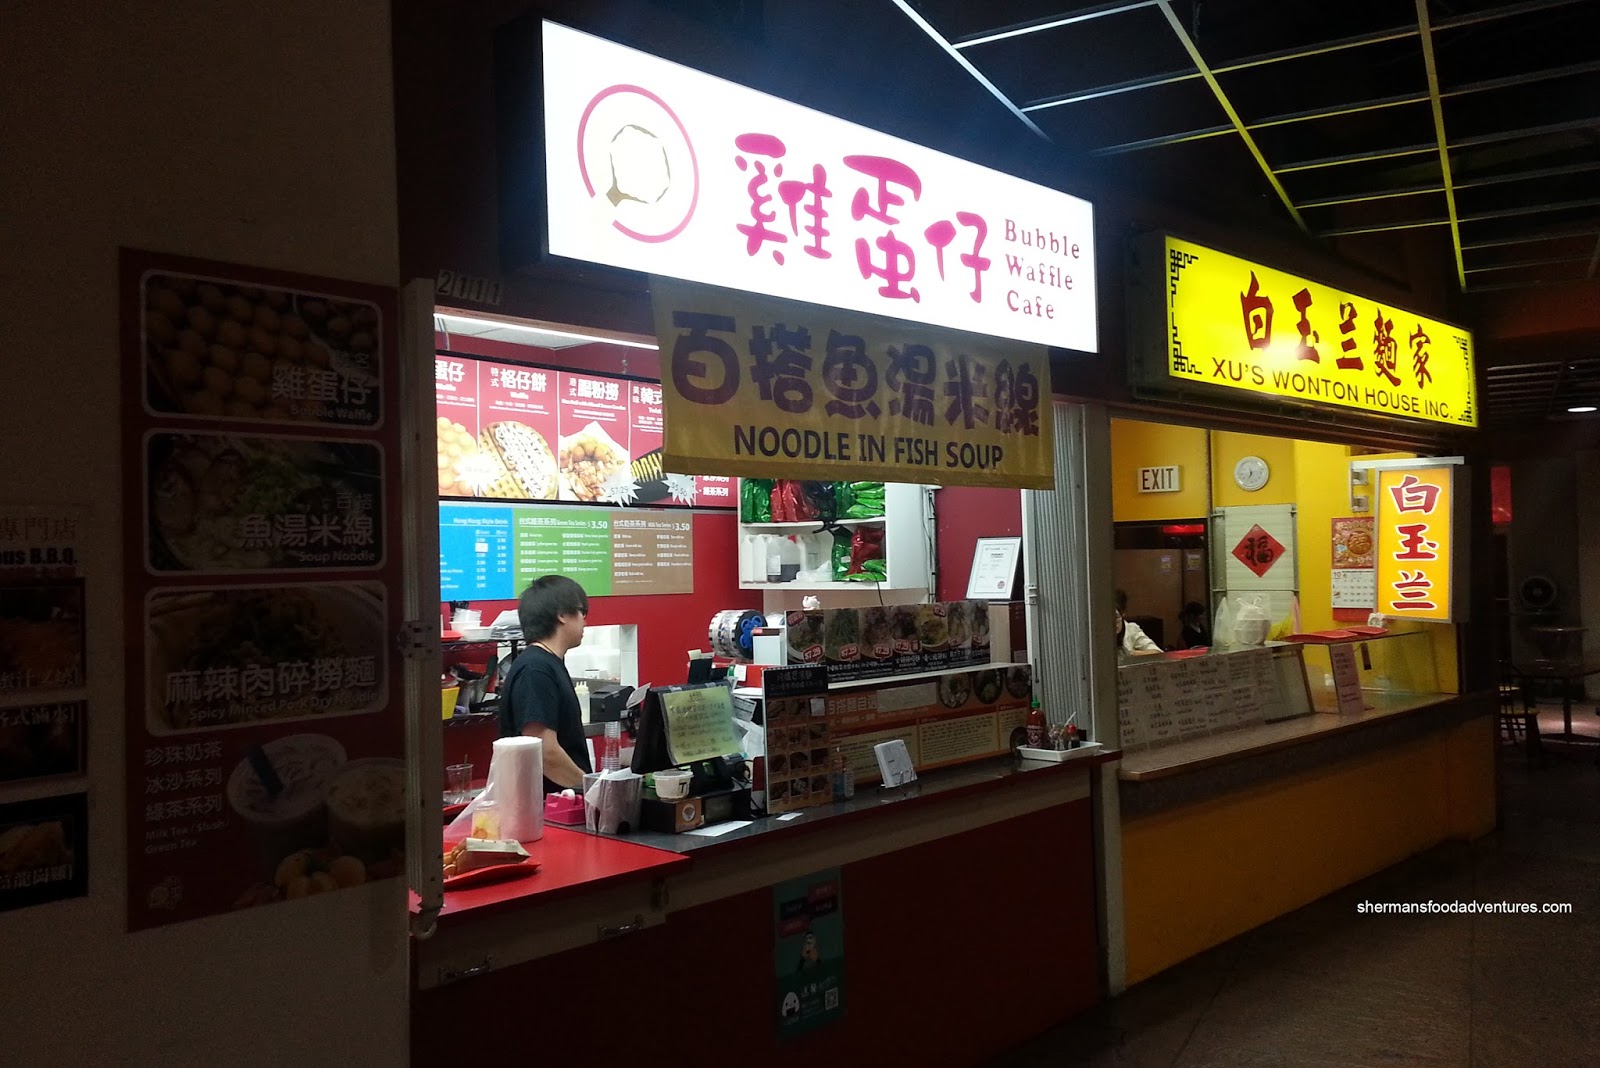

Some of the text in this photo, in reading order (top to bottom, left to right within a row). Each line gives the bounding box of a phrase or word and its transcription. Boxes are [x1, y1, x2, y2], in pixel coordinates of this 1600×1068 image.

[734, 132, 991, 304] 雞蛋仔
[1005, 218, 1080, 259] Bubble
[438, 271, 500, 304] 2111
[1005, 253, 1073, 291] Waffle
[1006, 290, 1054, 319] Cafe
[271, 365, 373, 405] 雞蛋仔
[500, 368, 547, 392] 格仔餅
[1212, 356, 1454, 420] XU'S WONTON HOUSE INC.
[336, 408, 374, 422] Waffle
[734, 424, 1004, 470] NOODLE IN FISH SOUP
[1142, 468, 1175, 491] EXIT
[240, 513, 375, 548] 魚湯米線
[1389, 474, 1443, 612] 白玉兰
[299, 549, 375, 563] Soup Noodle
[1244, 535, 1274, 567] 福
[165, 655, 377, 706] 麻辣肉碎撈麵
[189, 705, 226, 722] Spicy
[228, 701, 276, 717] Minced
[310, 695, 332, 711] Dry
[144, 740, 223, 767] 珍珠奶茶
[144, 767, 223, 794] 冰沙系列
[144, 793, 223, 823] 綠茶系列
[171, 826, 189, 837] Tea
